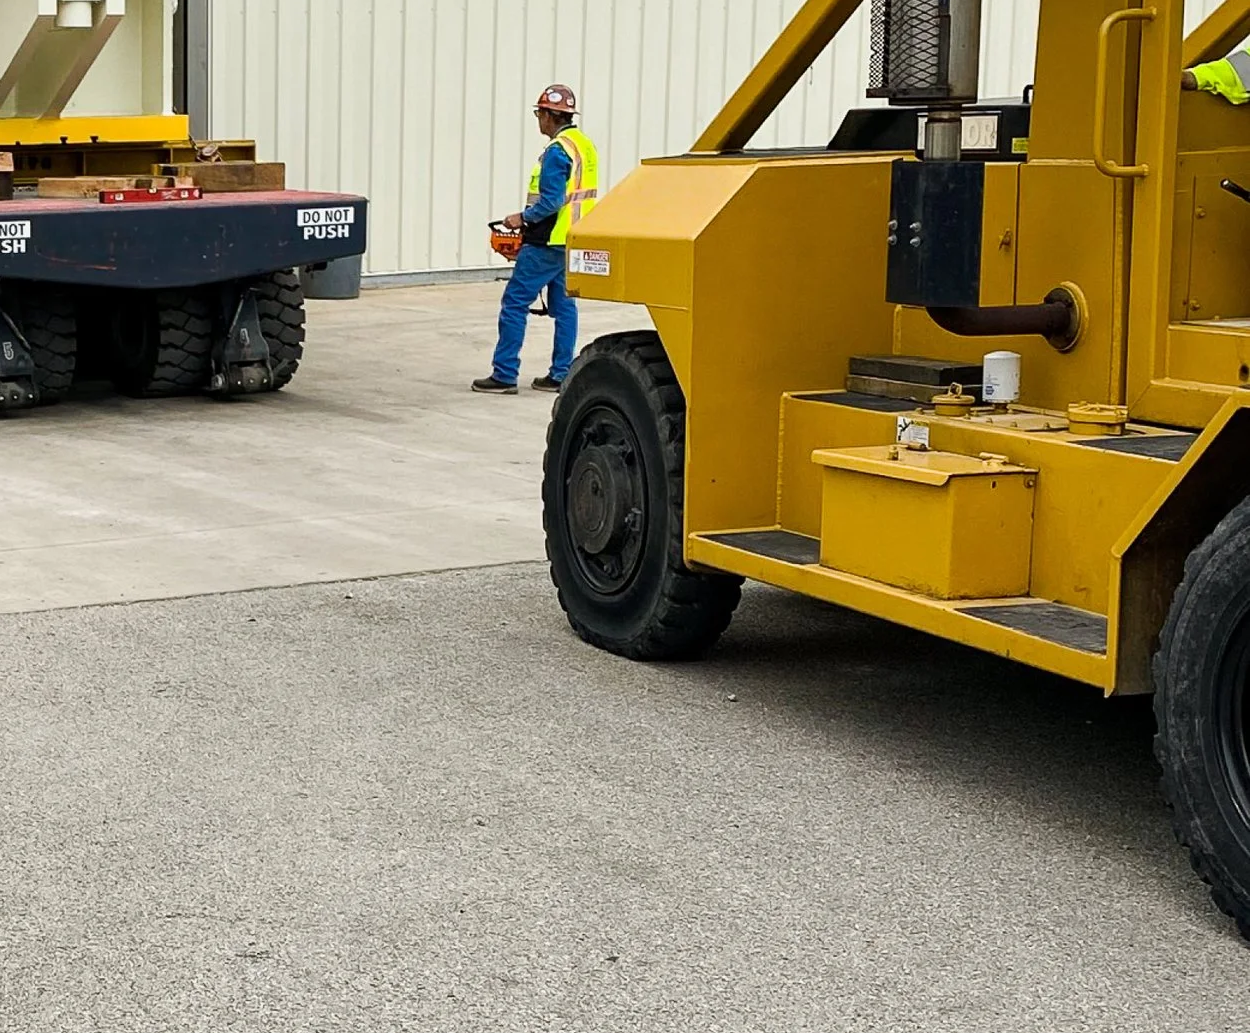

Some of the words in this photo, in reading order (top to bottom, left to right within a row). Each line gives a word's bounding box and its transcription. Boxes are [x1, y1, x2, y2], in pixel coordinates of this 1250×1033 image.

[302, 210, 320, 224] DO
[324, 209, 350, 223] NOT
[303, 224, 350, 240] PUSH
[2, 341, 15, 360] 5
